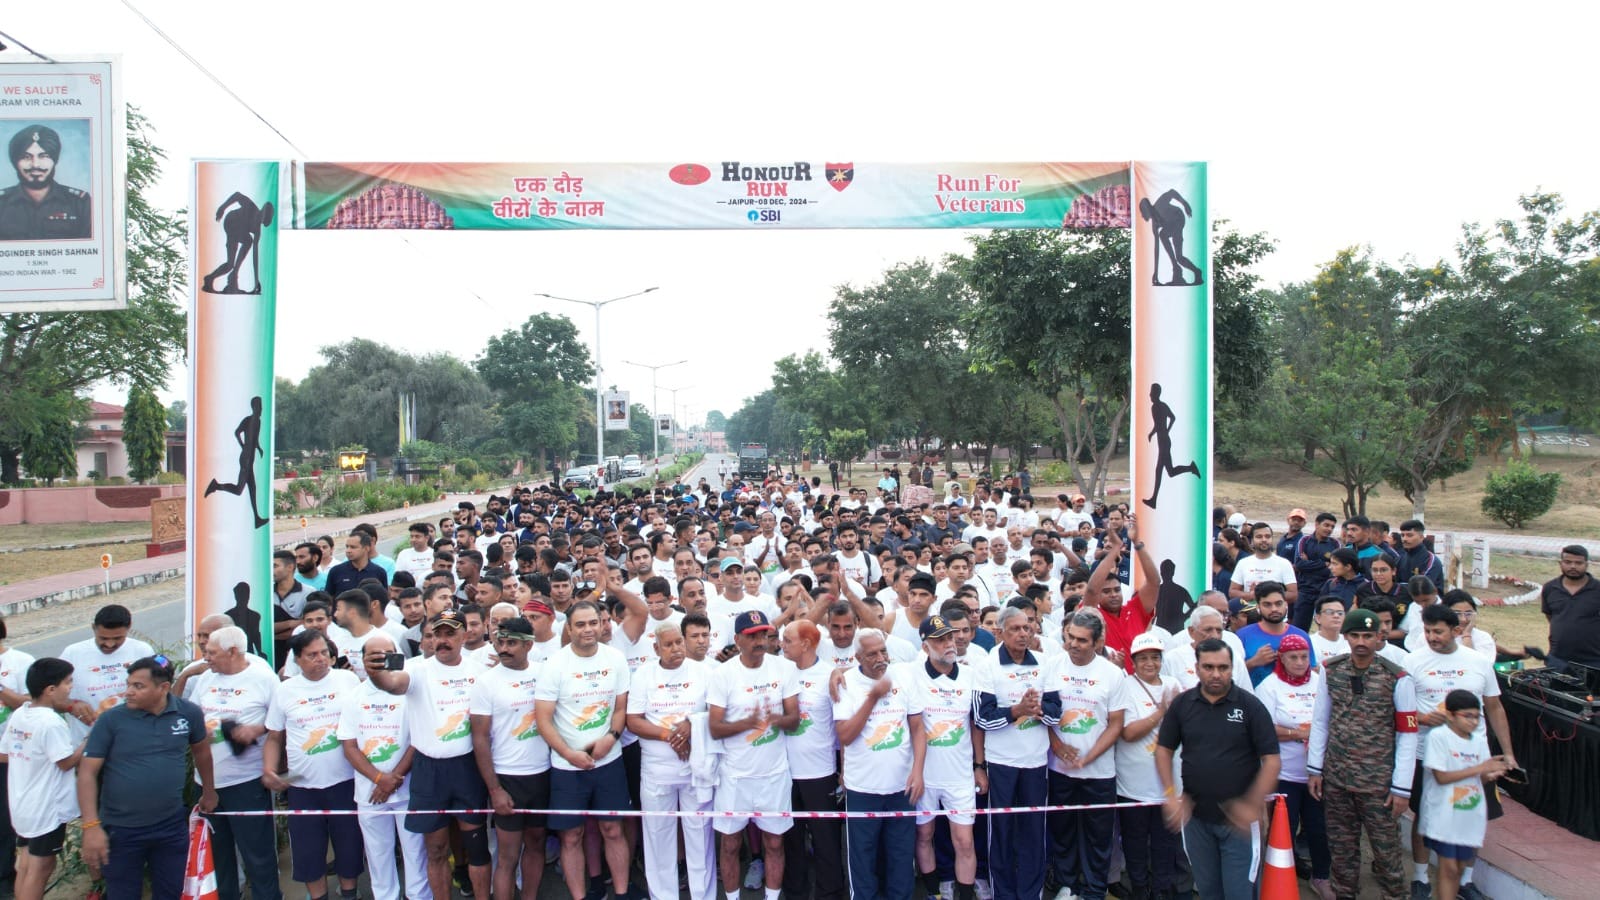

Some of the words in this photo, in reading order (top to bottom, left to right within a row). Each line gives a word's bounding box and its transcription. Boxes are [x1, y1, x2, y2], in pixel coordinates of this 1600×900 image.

[3, 86, 21, 95] WE
[25, 86, 68, 95] SALUTE
[514, 177, 547, 193] एक
[552, 171, 584, 198] दौड़
[747, 181, 788, 197] RUN
[937, 174, 980, 192] Run
[984, 174, 1021, 192] For
[493, 197, 531, 218] वीरों
[537, 197, 558, 217] के
[564, 201, 605, 217] नाम
[934, 194, 1025, 213] Veterans
[760, 210, 781, 222] SBI
[65, 248, 99, 256] SAHNAN
